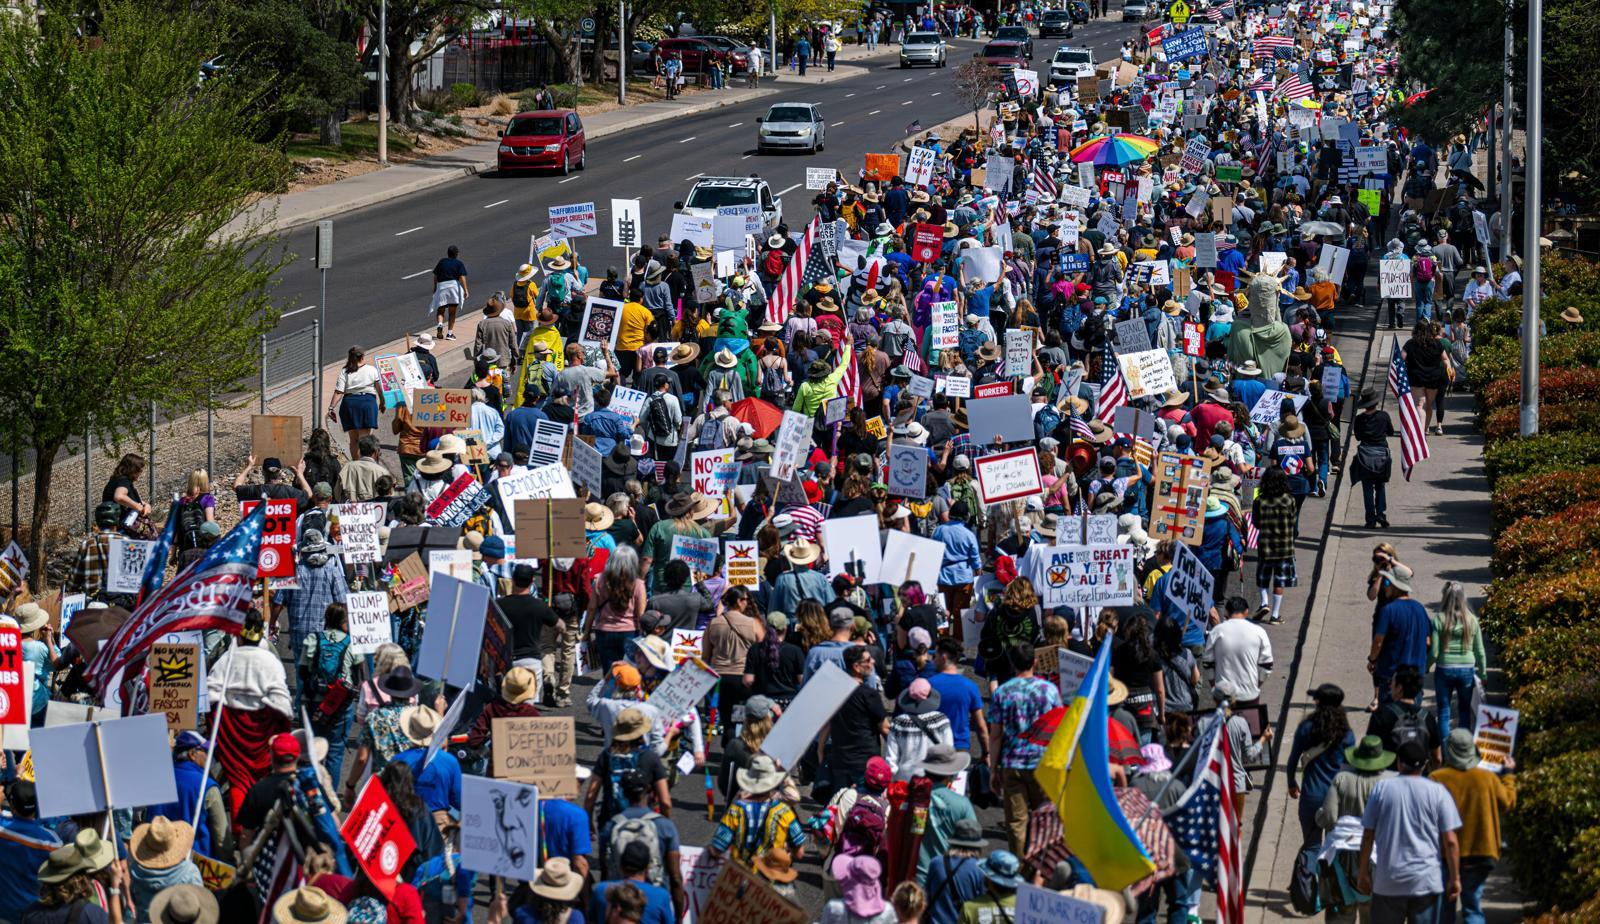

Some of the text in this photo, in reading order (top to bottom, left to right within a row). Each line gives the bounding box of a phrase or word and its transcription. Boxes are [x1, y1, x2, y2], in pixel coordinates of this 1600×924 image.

[1190, 140, 1210, 153] FIGHT
[914, 149, 933, 159] END
[1187, 147, 1205, 159] CRIME
[911, 157, 932, 167] IRAN
[912, 166, 928, 176] WAR
[1103, 173, 1122, 182] ICE
[1062, 255, 1075, 263] NO
[1062, 262, 1087, 271] KINGS
[942, 302, 957, 311] WAR
[1118, 321, 1144, 332] STAND
[942, 336, 959, 345] KINGS
[978, 386, 1009, 397] WORKERS
[421, 393, 440, 404] ESE
[417, 410, 468, 423] NO ES REY
[986, 461, 1008, 473] SHUT
[502, 466, 564, 497] DEMOCRACY
[264, 517, 291, 532] OT
[261, 534, 291, 545] MBS
[1052, 552, 1074, 565] ARE
[1093, 549, 1129, 561] GREAT
[1083, 561, 1112, 574] YET?
[351, 593, 382, 609] DUMP
[349, 611, 389, 625] TRUMP
[154, 646, 194, 655] NO KINGS
[163, 689, 179, 698] NO
[153, 699, 190, 709] FASCIST
[165, 711, 181, 724] SA
[508, 732, 568, 750] DEFEND
[506, 753, 576, 769] CONSTITUTION
[1029, 892, 1044, 913] NO
